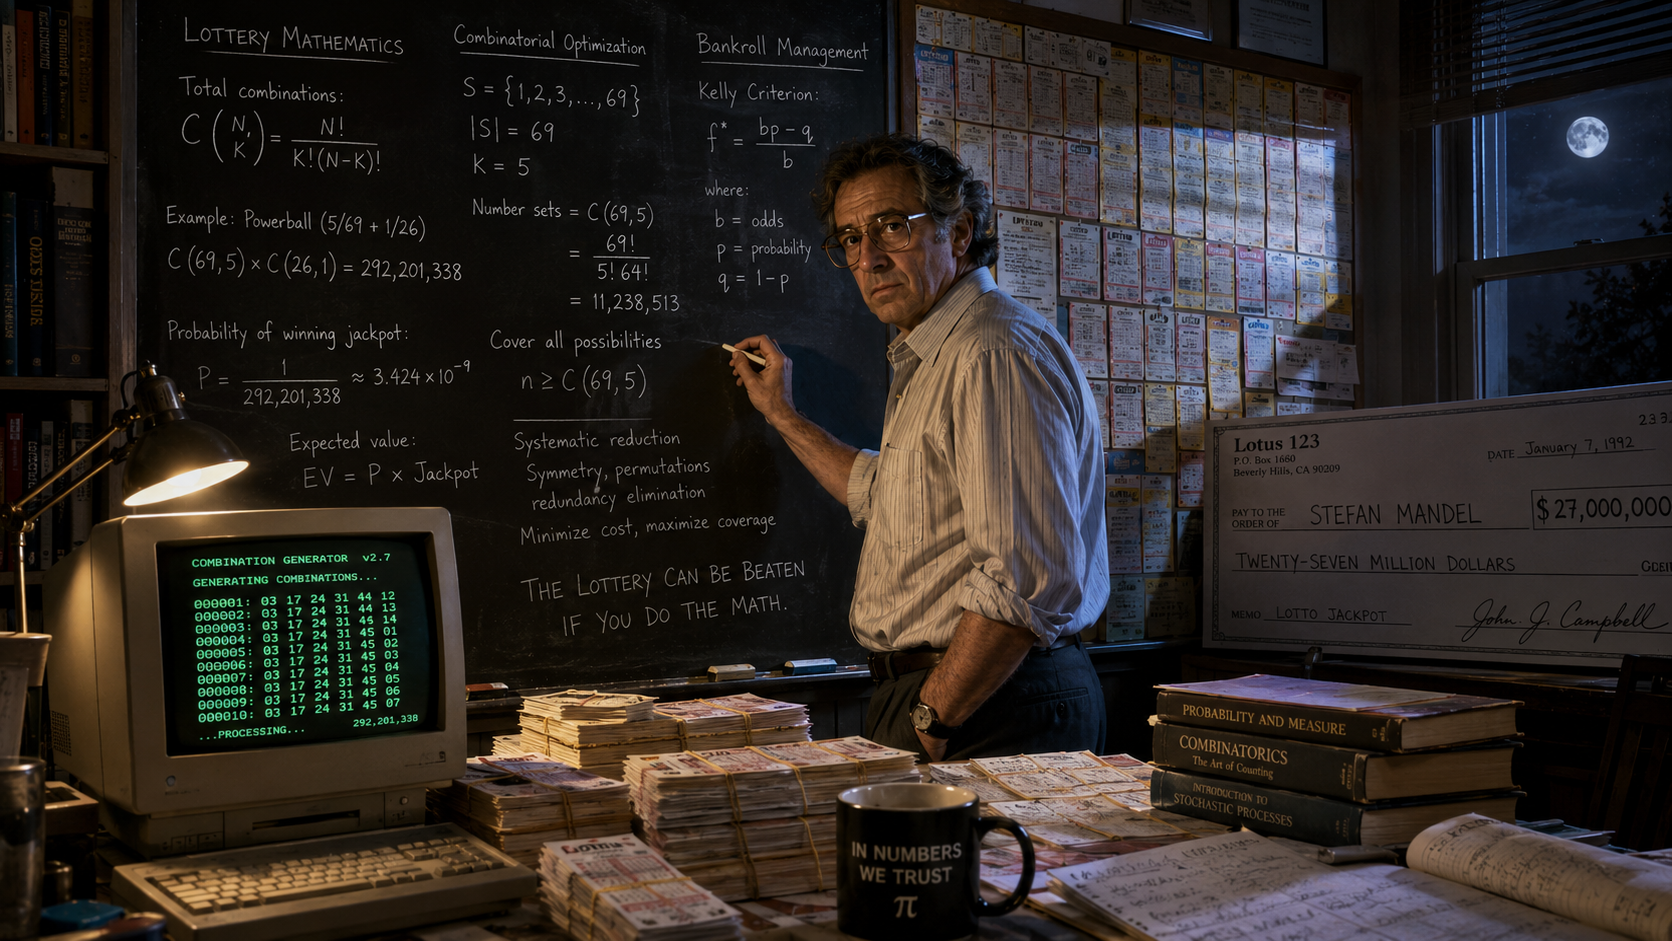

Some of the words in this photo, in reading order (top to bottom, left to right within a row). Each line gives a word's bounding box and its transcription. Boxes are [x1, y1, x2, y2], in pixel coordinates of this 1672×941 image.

[185, 17, 269, 53] LOTTERY
[282, 26, 403, 56] MATHEMATICS
[454, 24, 554, 48] Combinatorial
[564, 34, 646, 58] Optimization
[696, 33, 766, 55] Bankroll
[775, 38, 869, 68] Management
[179, 76, 226, 97] Total
[239, 81, 343, 103] combinations:
[464, 77, 475, 97] S
[699, 81, 736, 108] Kelly
[748, 83, 818, 101] Criterion:
[474, 154, 486, 174] K
[519, 158, 530, 176] 5
[705, 182, 748, 196] where:
[473, 198, 525, 215] Number
[534, 203, 561, 217] sets
[715, 209, 724, 227] b
[752, 210, 783, 227] odds
[167, 205, 235, 233] Example:
[245, 210, 311, 229] Powerball
[717, 244, 726, 263] p
[752, 239, 811, 263] probability
[361, 259, 461, 283] 292,201,338
[718, 274, 729, 293] q
[594, 293, 679, 315] 11,238,513
[168, 320, 247, 349] Probability
[257, 320, 271, 341] of
[283, 325, 335, 350] winning
[345, 324, 409, 348] jackpot:
[491, 330, 535, 349] Cover
[546, 330, 563, 348] all
[575, 332, 661, 357] possibilities
[198, 366, 210, 389] P
[282, 359, 286, 375] 1
[522, 376, 533, 389] n
[244, 388, 340, 408] 292,201,338
[290, 431, 360, 457] Expected
[370, 430, 415, 447] value:
[515, 431, 599, 457] Systematic
[610, 430, 680, 446] reduction
[1235, 438, 1282, 452] Lotus
[1290, 434, 1319, 449] 123
[1488, 450, 1514, 459] DATE
[1525, 441, 1577, 458] January
[1584, 439, 1598, 454] 7,
[1605, 437, 1637, 451] 1992
[1234, 456, 1251, 466] P.O.
[1255, 456, 1271, 465] Box
[1276, 455, 1295, 463] 1660
[1234, 468, 1266, 478] Beverly
[1270, 467, 1292, 477] Hills,
[1296, 466, 1310, 474] CA
[1313, 464, 1340, 473] 90209
[304, 467, 333, 488] EV
[369, 463, 380, 485] P
[414, 461, 479, 487] Jackpot
[527, 462, 607, 490] Symmetry,
[616, 457, 710, 480] permutations
[532, 492, 616, 512] redundancy
[627, 486, 705, 503] elimination
[1267, 508, 1285, 516] THE
[1311, 504, 1380, 525] STEFAN
[1398, 503, 1482, 524] MANDEL
[521, 526, 590, 545] Minimize
[602, 518, 637, 538] cost,
[646, 519, 709, 532] maximize
[718, 516, 776, 534] coverage
[1232, 520, 1264, 528] ORDER
[192, 557, 275, 567] COMBINATION
[283, 555, 348, 564] GENERATOR
[363, 553, 390, 561] v2.7
[1235, 552, 1359, 574] TWENTY-SEVEN
[1370, 554, 1435, 571] MILLION
[1447, 555, 1515, 571] DOLLARS
[193, 576, 268, 587] GENERATING
[277, 573, 377, 583] COMBINATIONS...
[521, 578, 563, 601] THE
[577, 573, 651, 597] LOTTERY
[665, 567, 698, 587] CAN
[710, 565, 731, 583] BE
[742, 560, 804, 581] BEATEN
[194, 598, 249, 609] 000001:
[261, 596, 276, 606] 03
[287, 595, 301, 604] 17
[311, 594, 325, 603] 24
[335, 593, 348, 602] 31
[358, 592, 372, 601] 44
[382, 591, 395, 600] 12
[563, 614, 581, 636] IF
[596, 611, 631, 633] YOU
[645, 607, 670, 626] DO
[681, 601, 718, 620] THE
[732, 595, 787, 615] MATH.
[1232, 610, 1261, 619] MEMO
[1277, 606, 1317, 619] LOTTO
[1327, 608, 1387, 622] JACKPOT
[1559, 600, 1669, 643] Campbell
[353, 714, 418, 727] 292,201,338
[1183, 704, 1254, 723] PROBABILITY
[1259, 715, 1284, 727] AND
[1289, 718, 1346, 735] MEASURE
[1180, 735, 1287, 765] COMBINATORICS
[1193, 756, 1207, 766] The
[1210, 759, 1222, 769] Art
[1226, 761, 1234, 770] of
[1237, 761, 1274, 780] Counting
[1192, 783, 1253, 803] INTRODUCTION
[1257, 795, 1267, 805] TO
[1173, 793, 1234, 815] STOCHASTIC
[1238, 806, 1292, 827] PROCESSES
[852, 841, 866, 858] IN
[874, 841, 962, 861] NUMBERS
[860, 865, 885, 883] WE
[893, 866, 952, 884] TRUST
